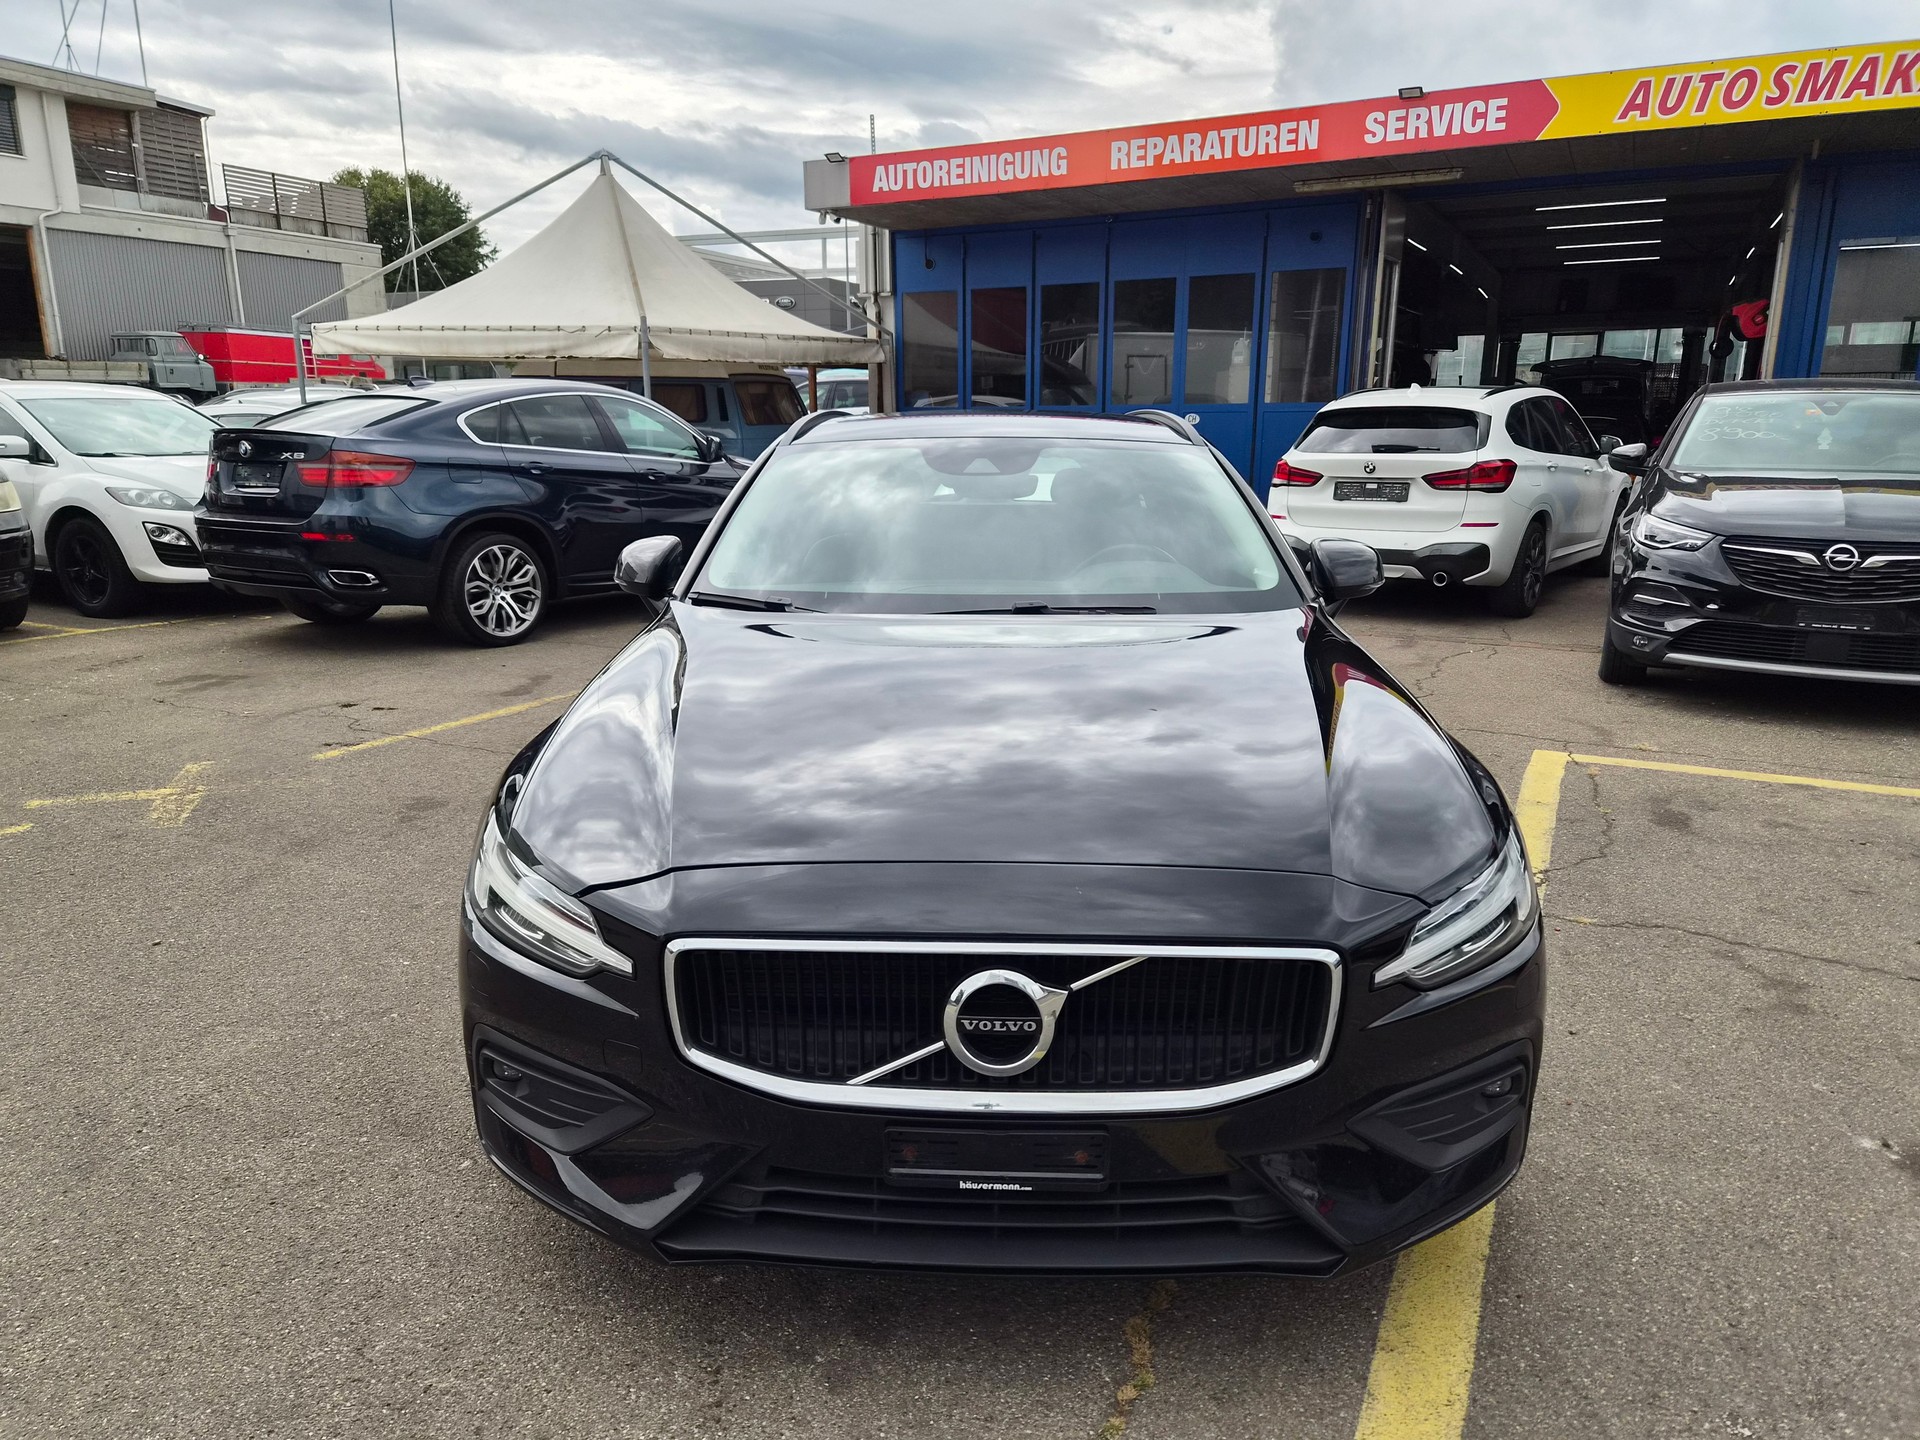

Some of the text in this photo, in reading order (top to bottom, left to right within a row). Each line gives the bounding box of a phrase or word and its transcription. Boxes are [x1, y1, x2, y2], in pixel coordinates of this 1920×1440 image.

[1614, 51, 1920, 122] AUTO SMAK
[1364, 98, 1508, 144] SERVICE
[1110, 119, 1319, 170] REPARATUREN
[872, 146, 1068, 193] AUTOREINIGUNG
[280, 452, 305, 460] X6
[961, 1020, 1037, 1031] VOLVO
